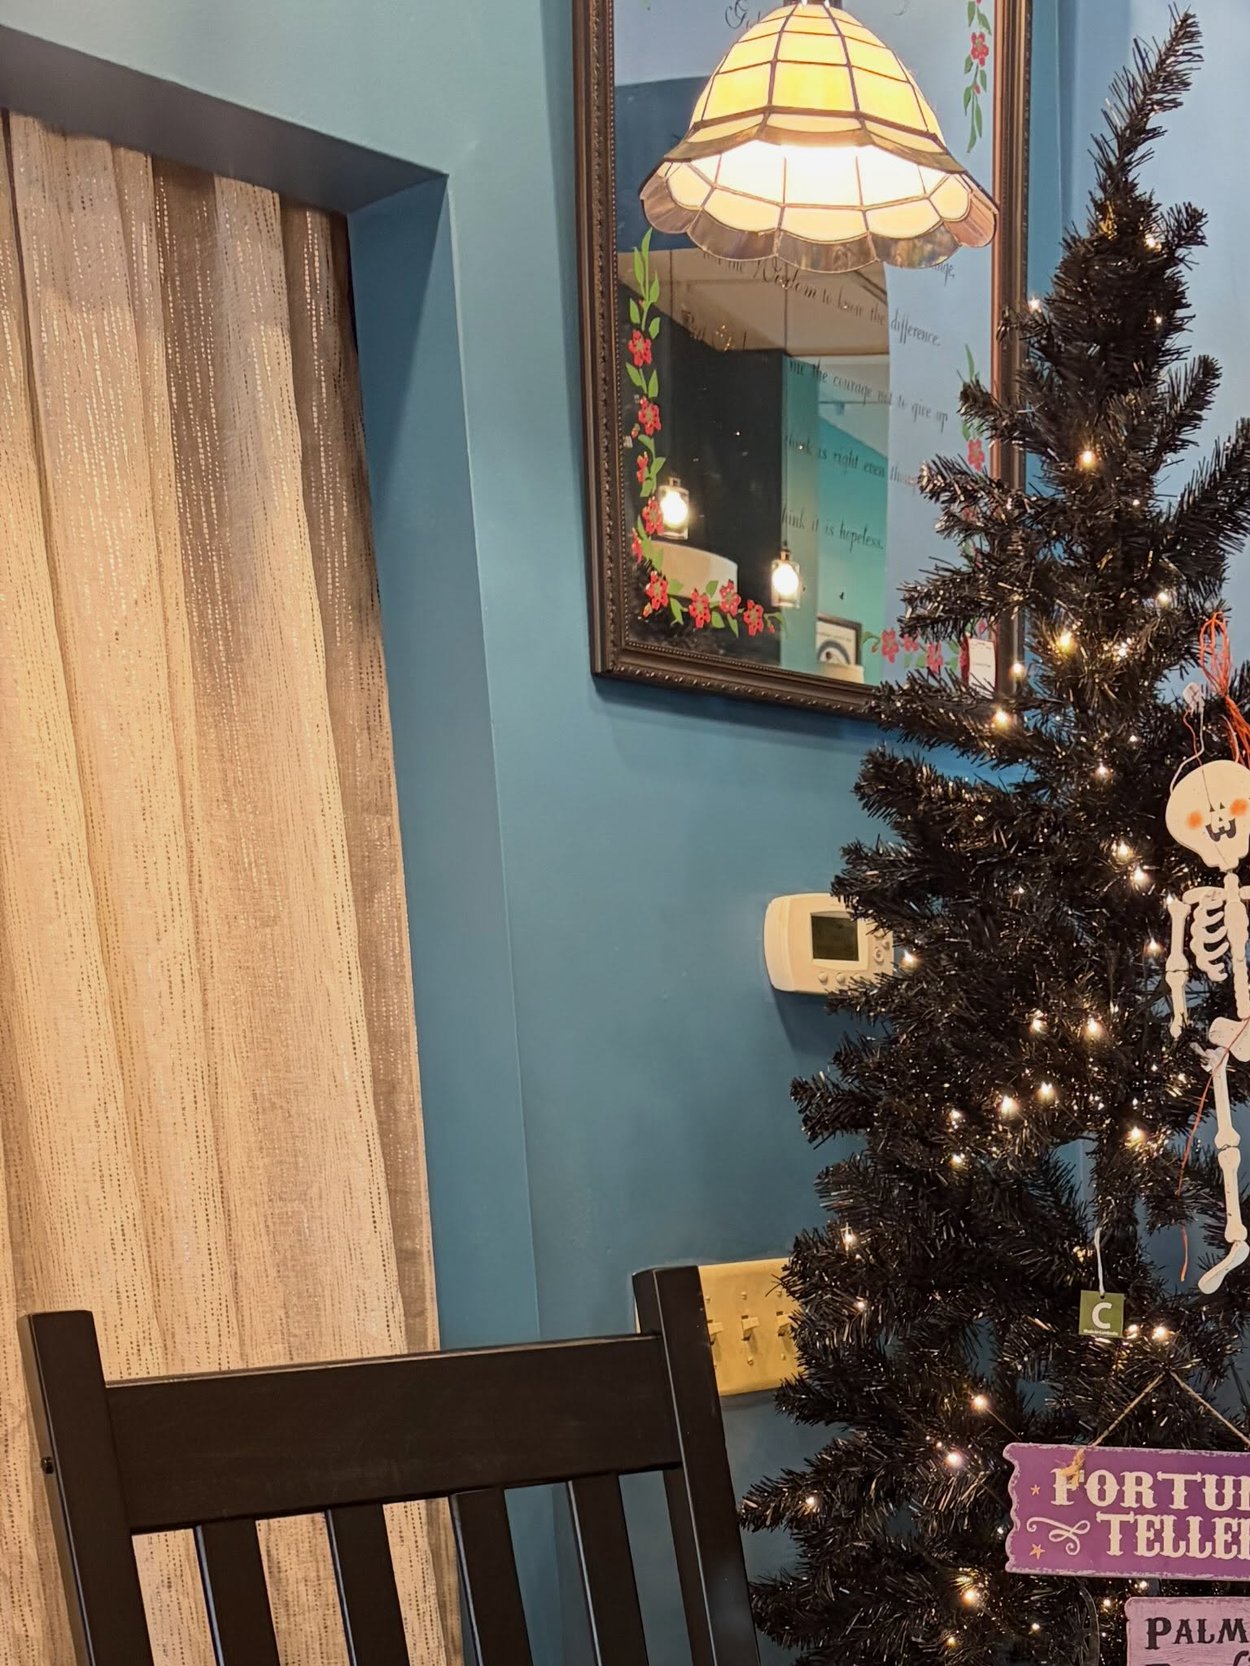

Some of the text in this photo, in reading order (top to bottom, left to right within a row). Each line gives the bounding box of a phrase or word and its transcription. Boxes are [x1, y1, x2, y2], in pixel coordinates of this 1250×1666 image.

[890, 308, 941, 346] difference.
[1092, 1302, 1112, 1329] C
[1144, 1616, 1249, 1650] PALM
